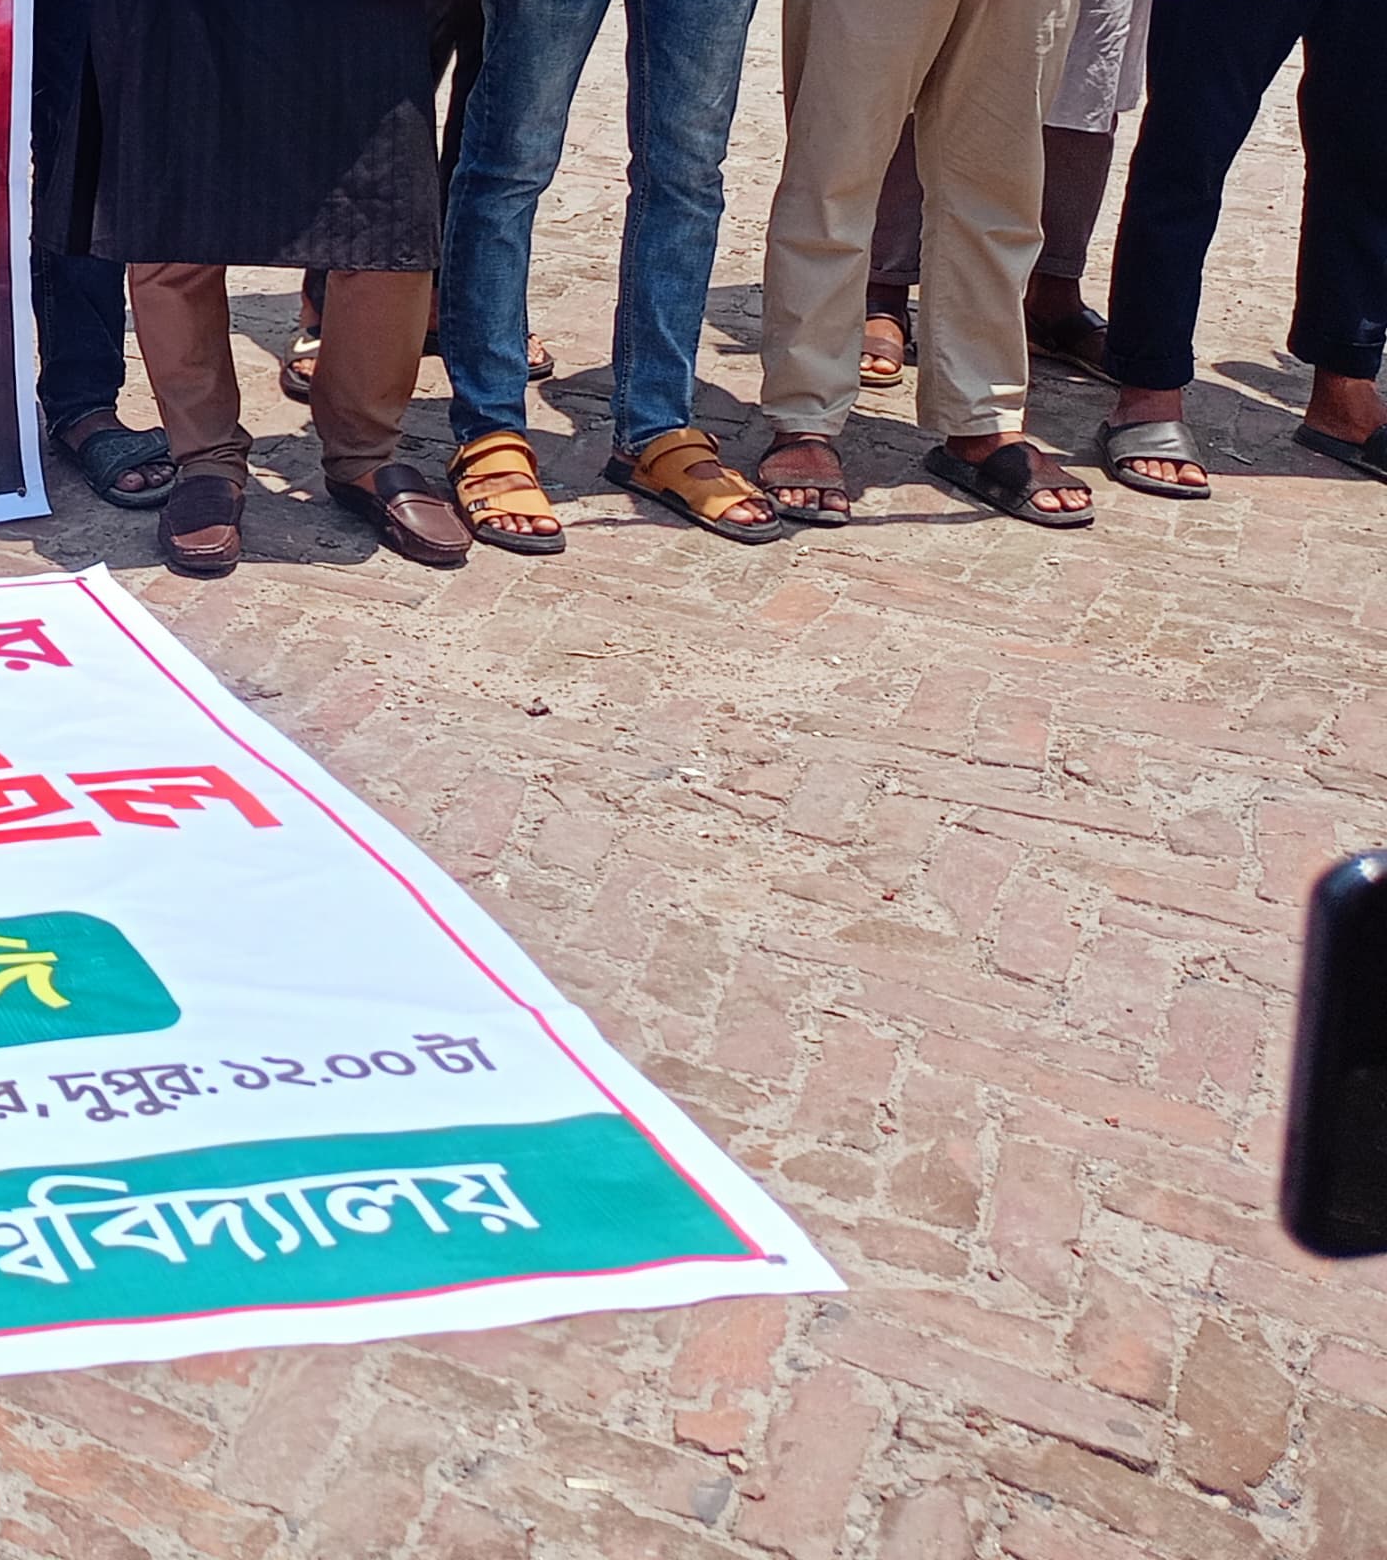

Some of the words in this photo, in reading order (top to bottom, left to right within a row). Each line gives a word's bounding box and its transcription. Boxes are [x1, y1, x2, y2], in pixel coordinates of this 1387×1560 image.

[50, 1061, 217, 1120] দুপুর:
[218, 1047, 416, 1092] ১২.০০
[416, 1032, 497, 1075] টা
